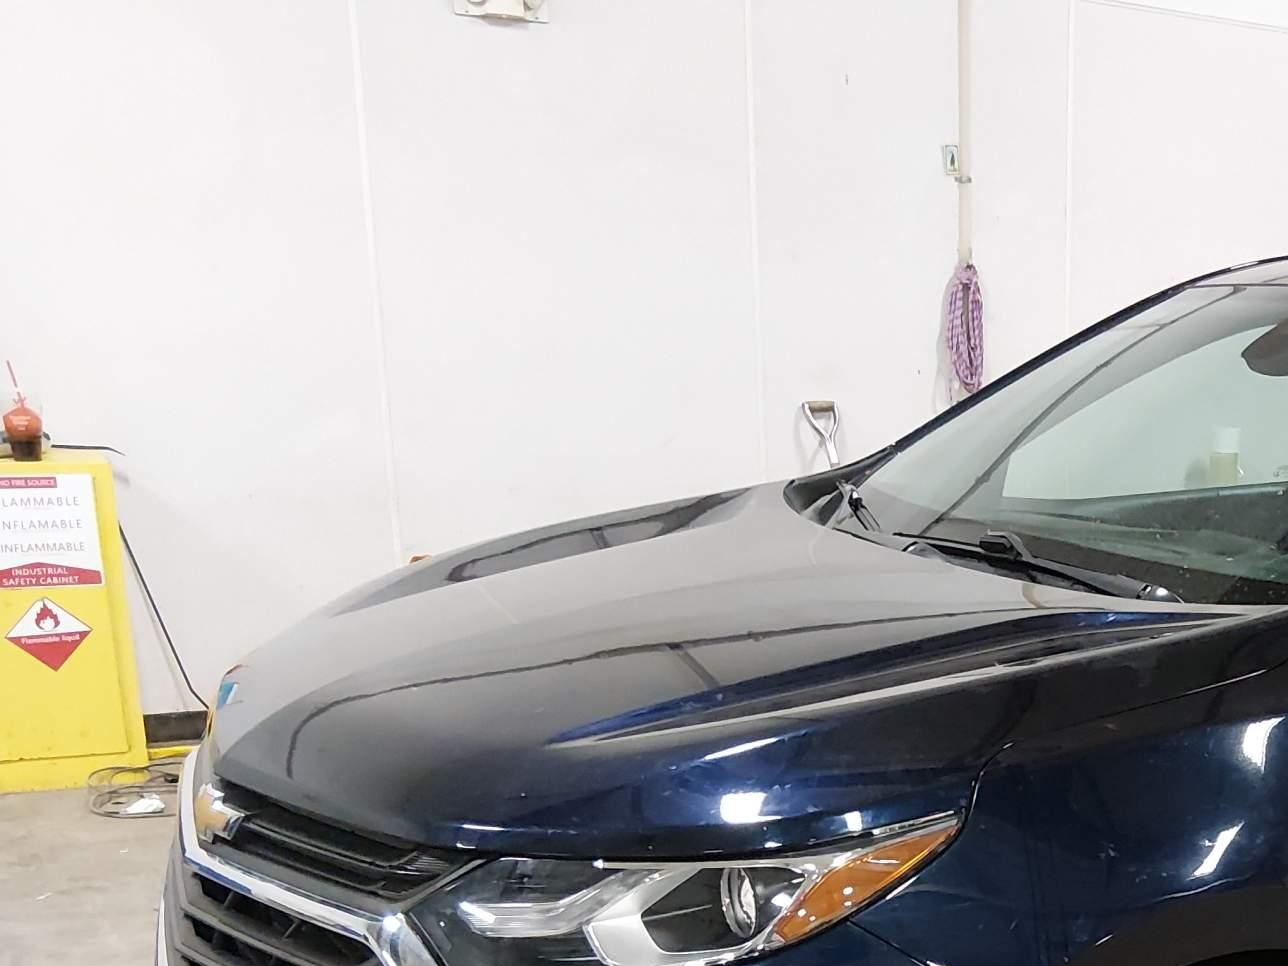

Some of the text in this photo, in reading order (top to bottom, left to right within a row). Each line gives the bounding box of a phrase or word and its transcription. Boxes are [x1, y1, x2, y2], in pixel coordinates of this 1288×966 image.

[0, 541, 85, 553] INFLAMMABLE
[11, 567, 69, 576] INDUSTRIAL
[2, 576, 80, 586] SAFETY CABINET
